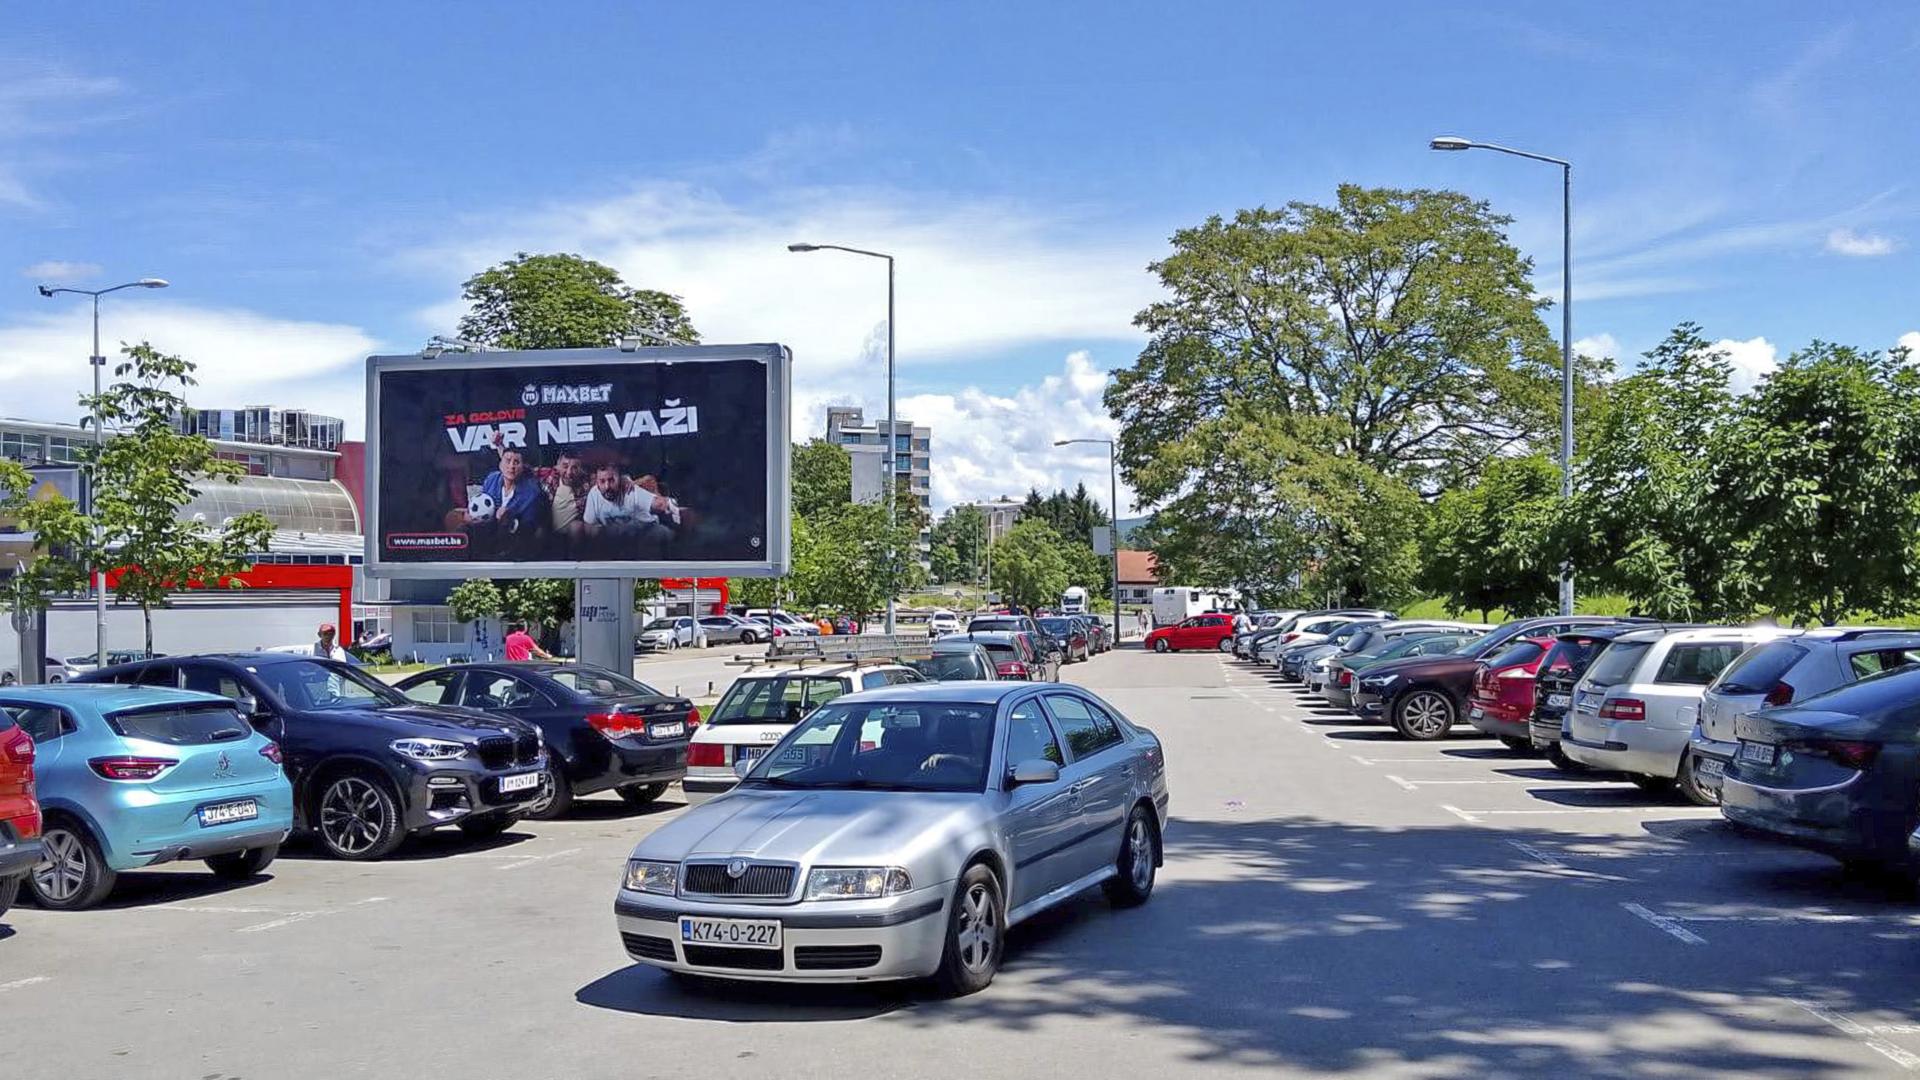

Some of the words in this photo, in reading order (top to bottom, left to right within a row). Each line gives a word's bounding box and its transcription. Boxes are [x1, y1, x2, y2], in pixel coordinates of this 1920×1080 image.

[541, 384, 613, 404] MAXBET
[447, 422, 527, 452] VAR
[538, 415, 594, 446] NE
[605, 398, 699, 439] VAŽI
[393, 537, 462, 545] www.maxbet.ba
